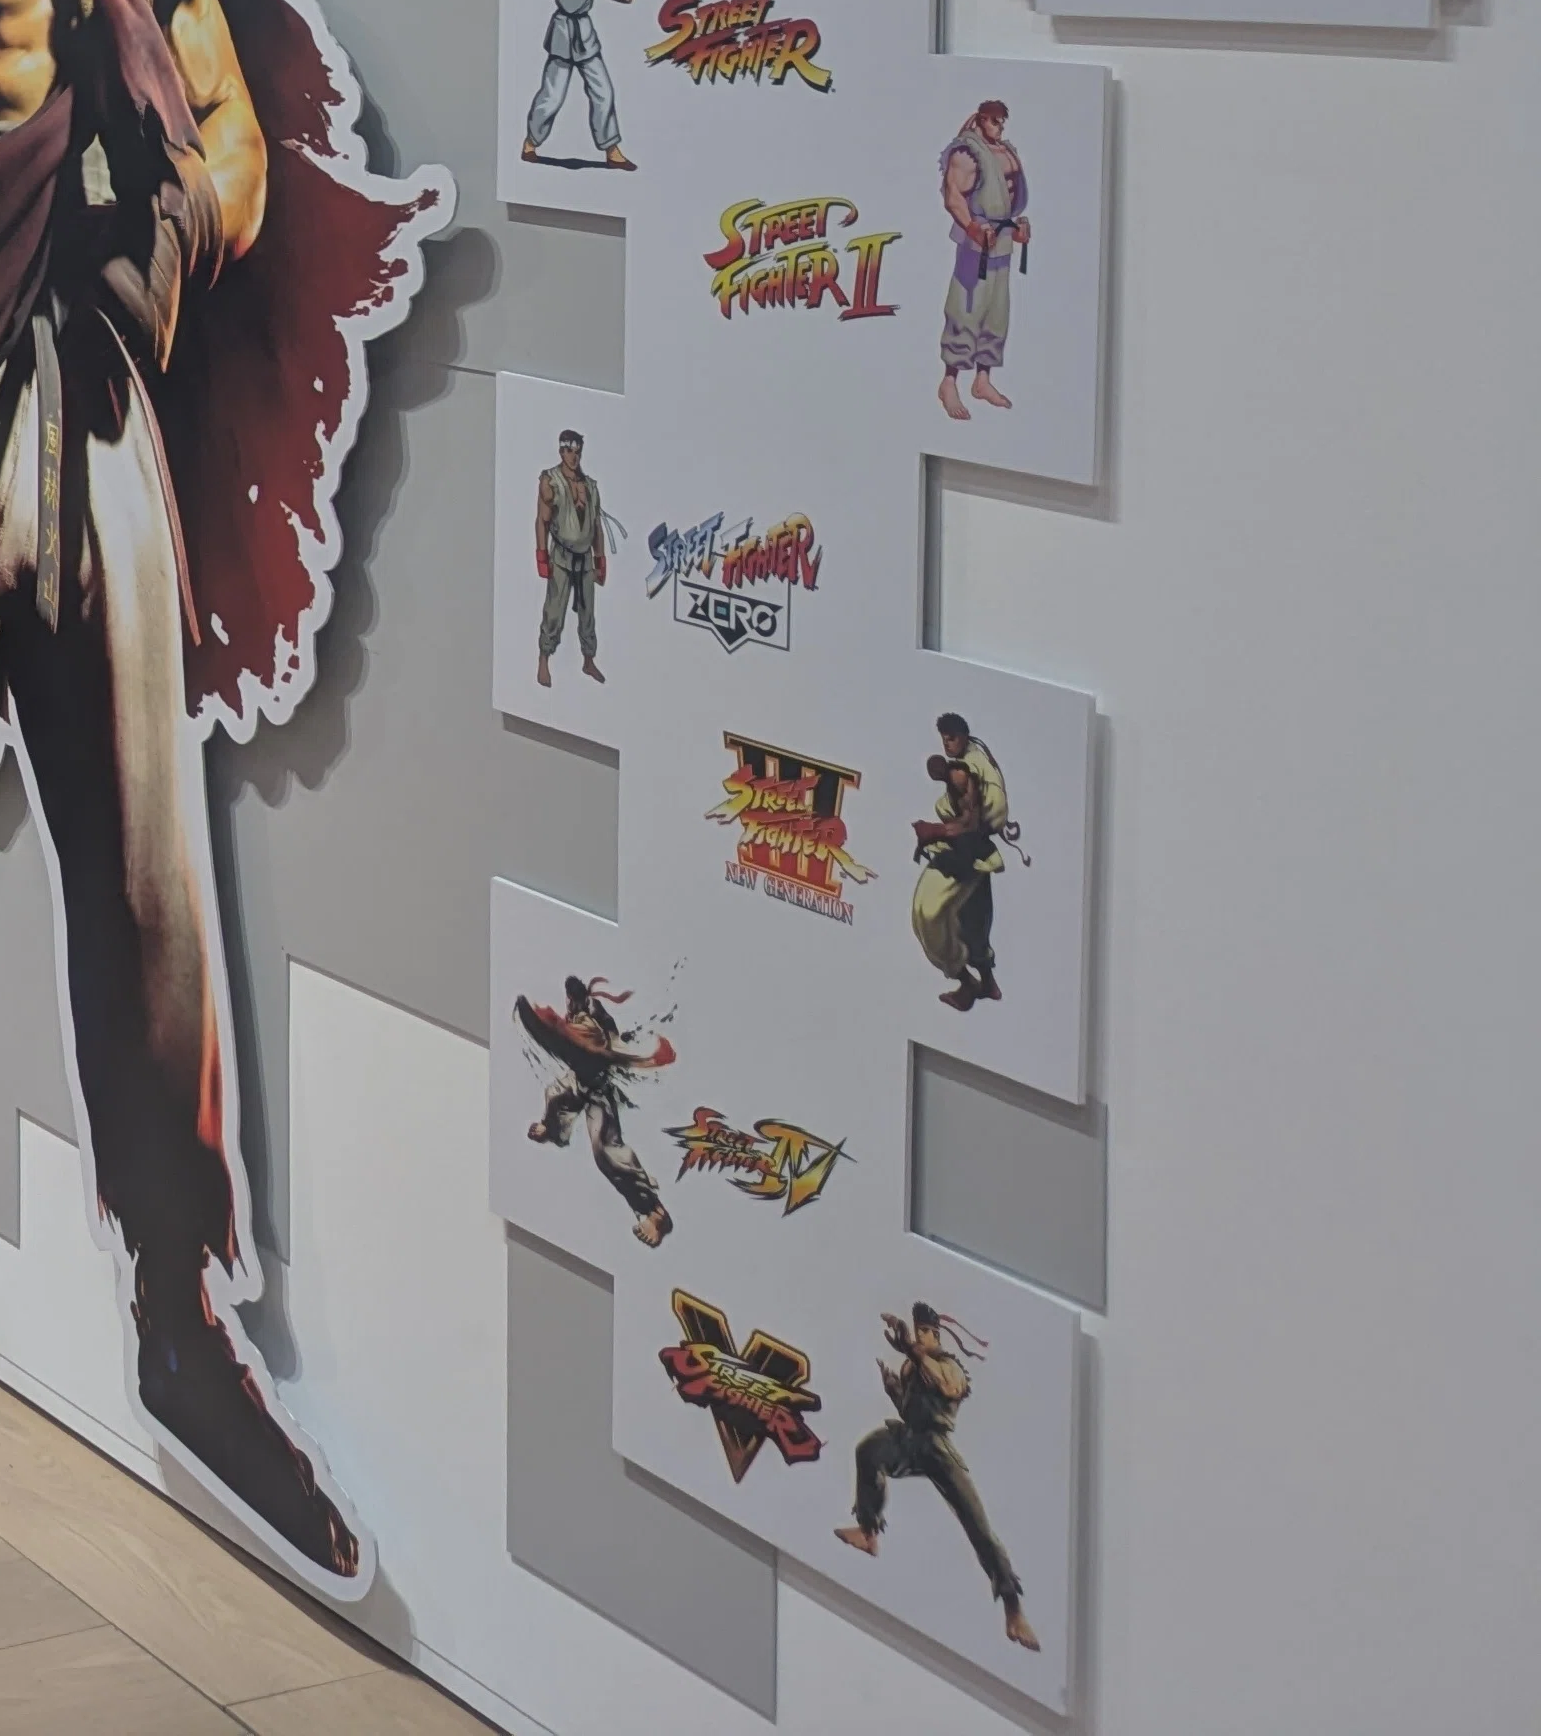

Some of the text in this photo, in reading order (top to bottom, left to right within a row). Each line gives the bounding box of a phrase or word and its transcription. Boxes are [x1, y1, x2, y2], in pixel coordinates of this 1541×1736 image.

[671, 18, 833, 94] FIGHTER
[703, 197, 903, 322] STREET FIGHTER II
[645, 511, 823, 600] STREET FIGHTER
[688, 591, 777, 638] ZERO
[704, 764, 879, 885] STREET FIGHTER
[725, 861, 854, 926] NEW GENERATION
[725, 1118, 857, 1218] IV
[658, 1341, 822, 1466] STREET FIGHTER
